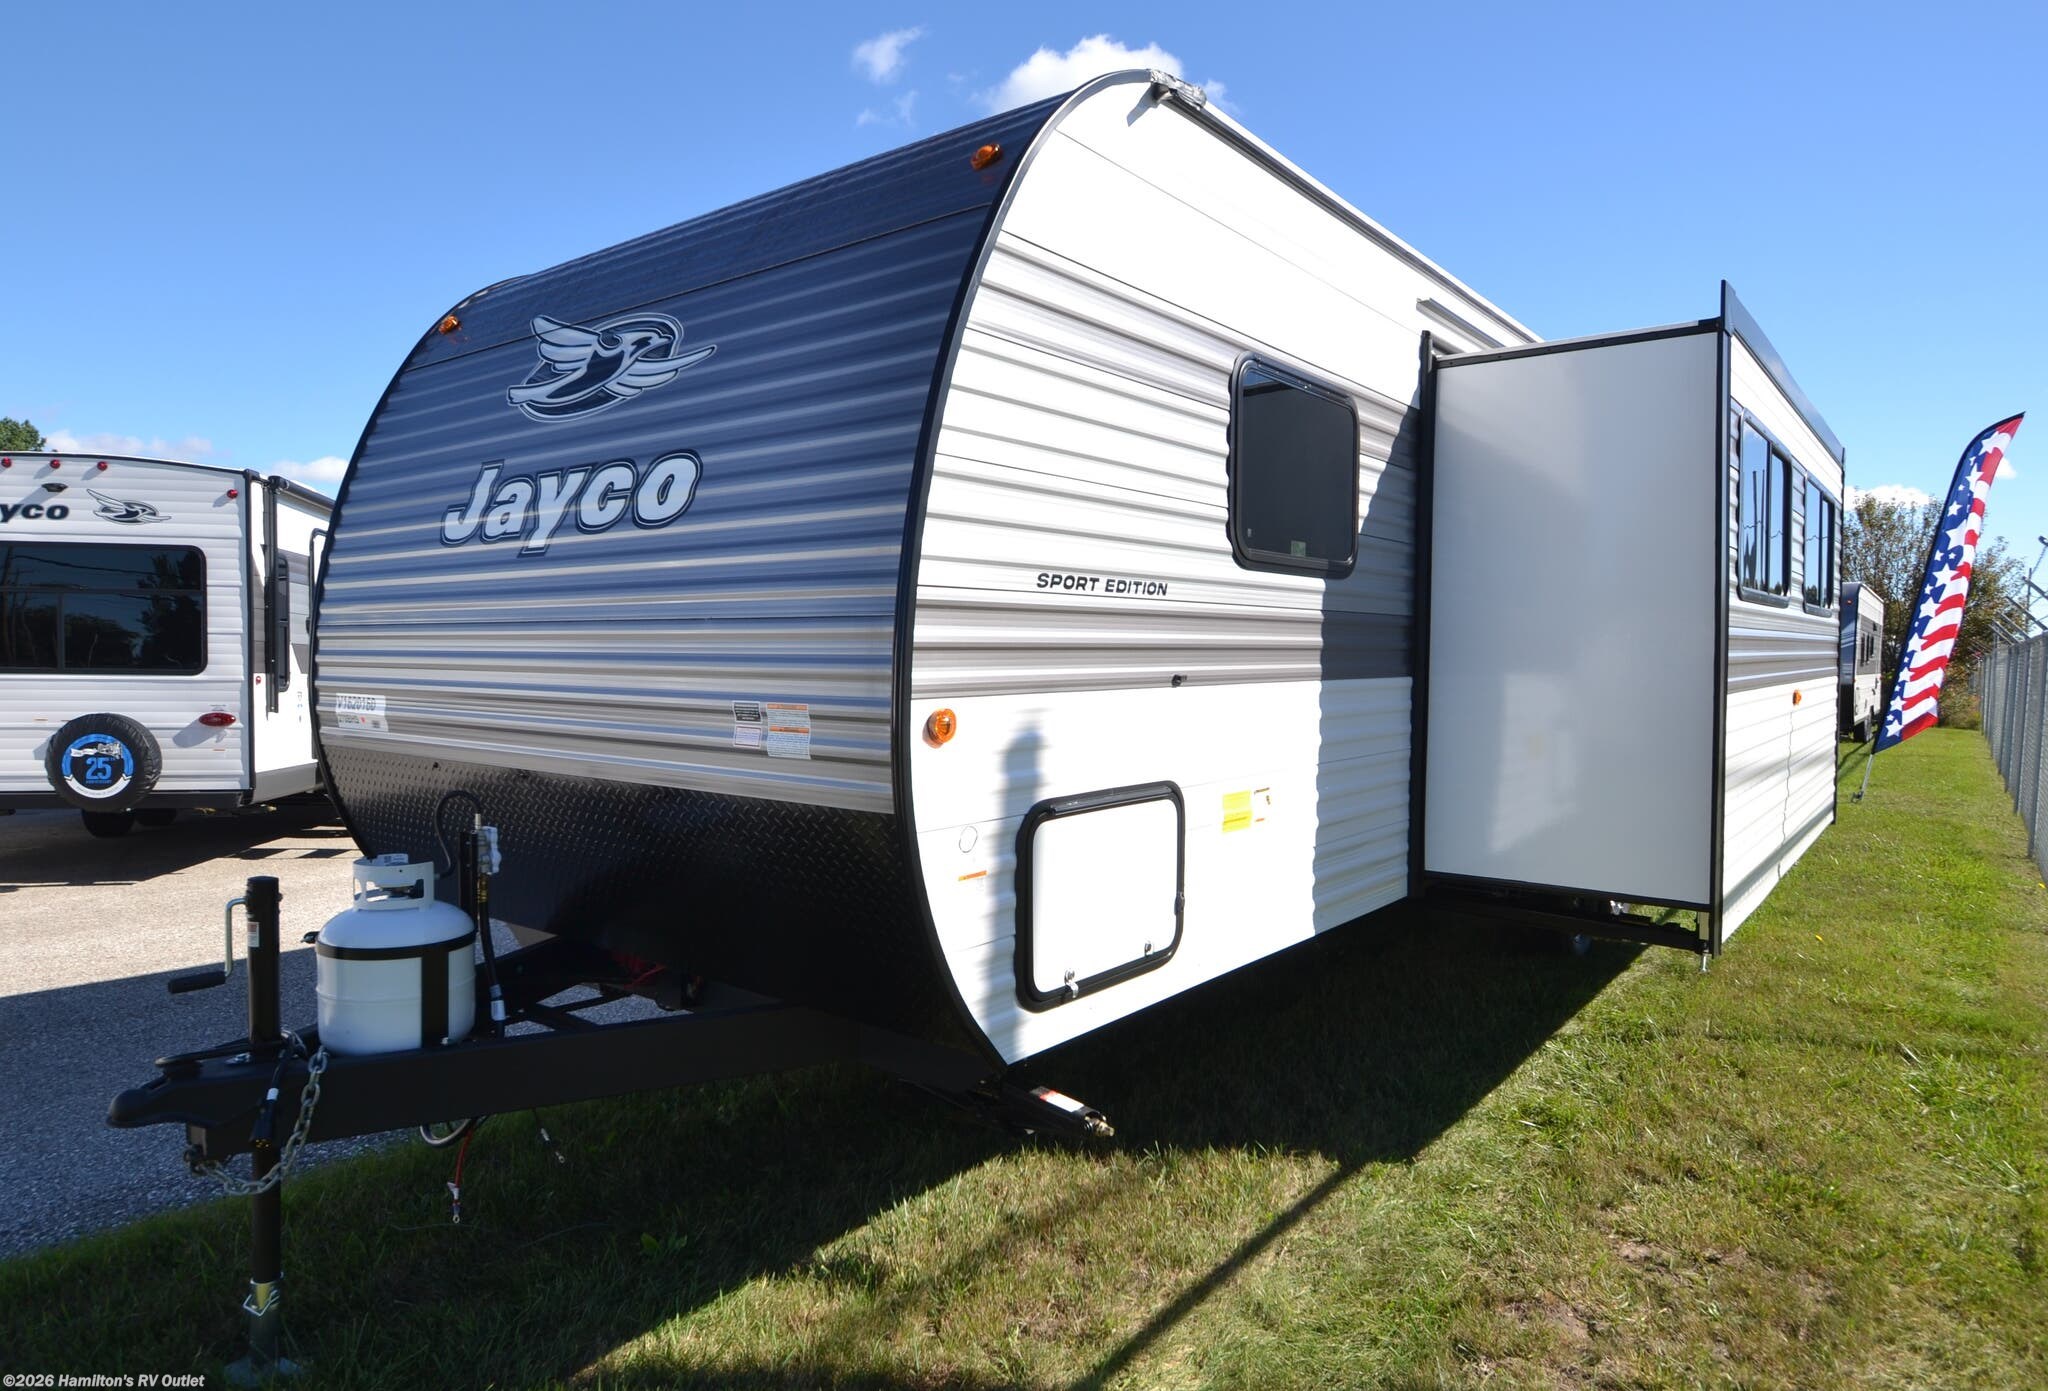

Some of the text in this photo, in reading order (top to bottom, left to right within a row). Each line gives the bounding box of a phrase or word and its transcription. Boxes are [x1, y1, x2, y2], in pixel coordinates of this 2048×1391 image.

[440, 449, 703, 558] Jayco
[1036, 572, 1169, 597] SPORT EDITION
[85, 757, 112, 780] 25
